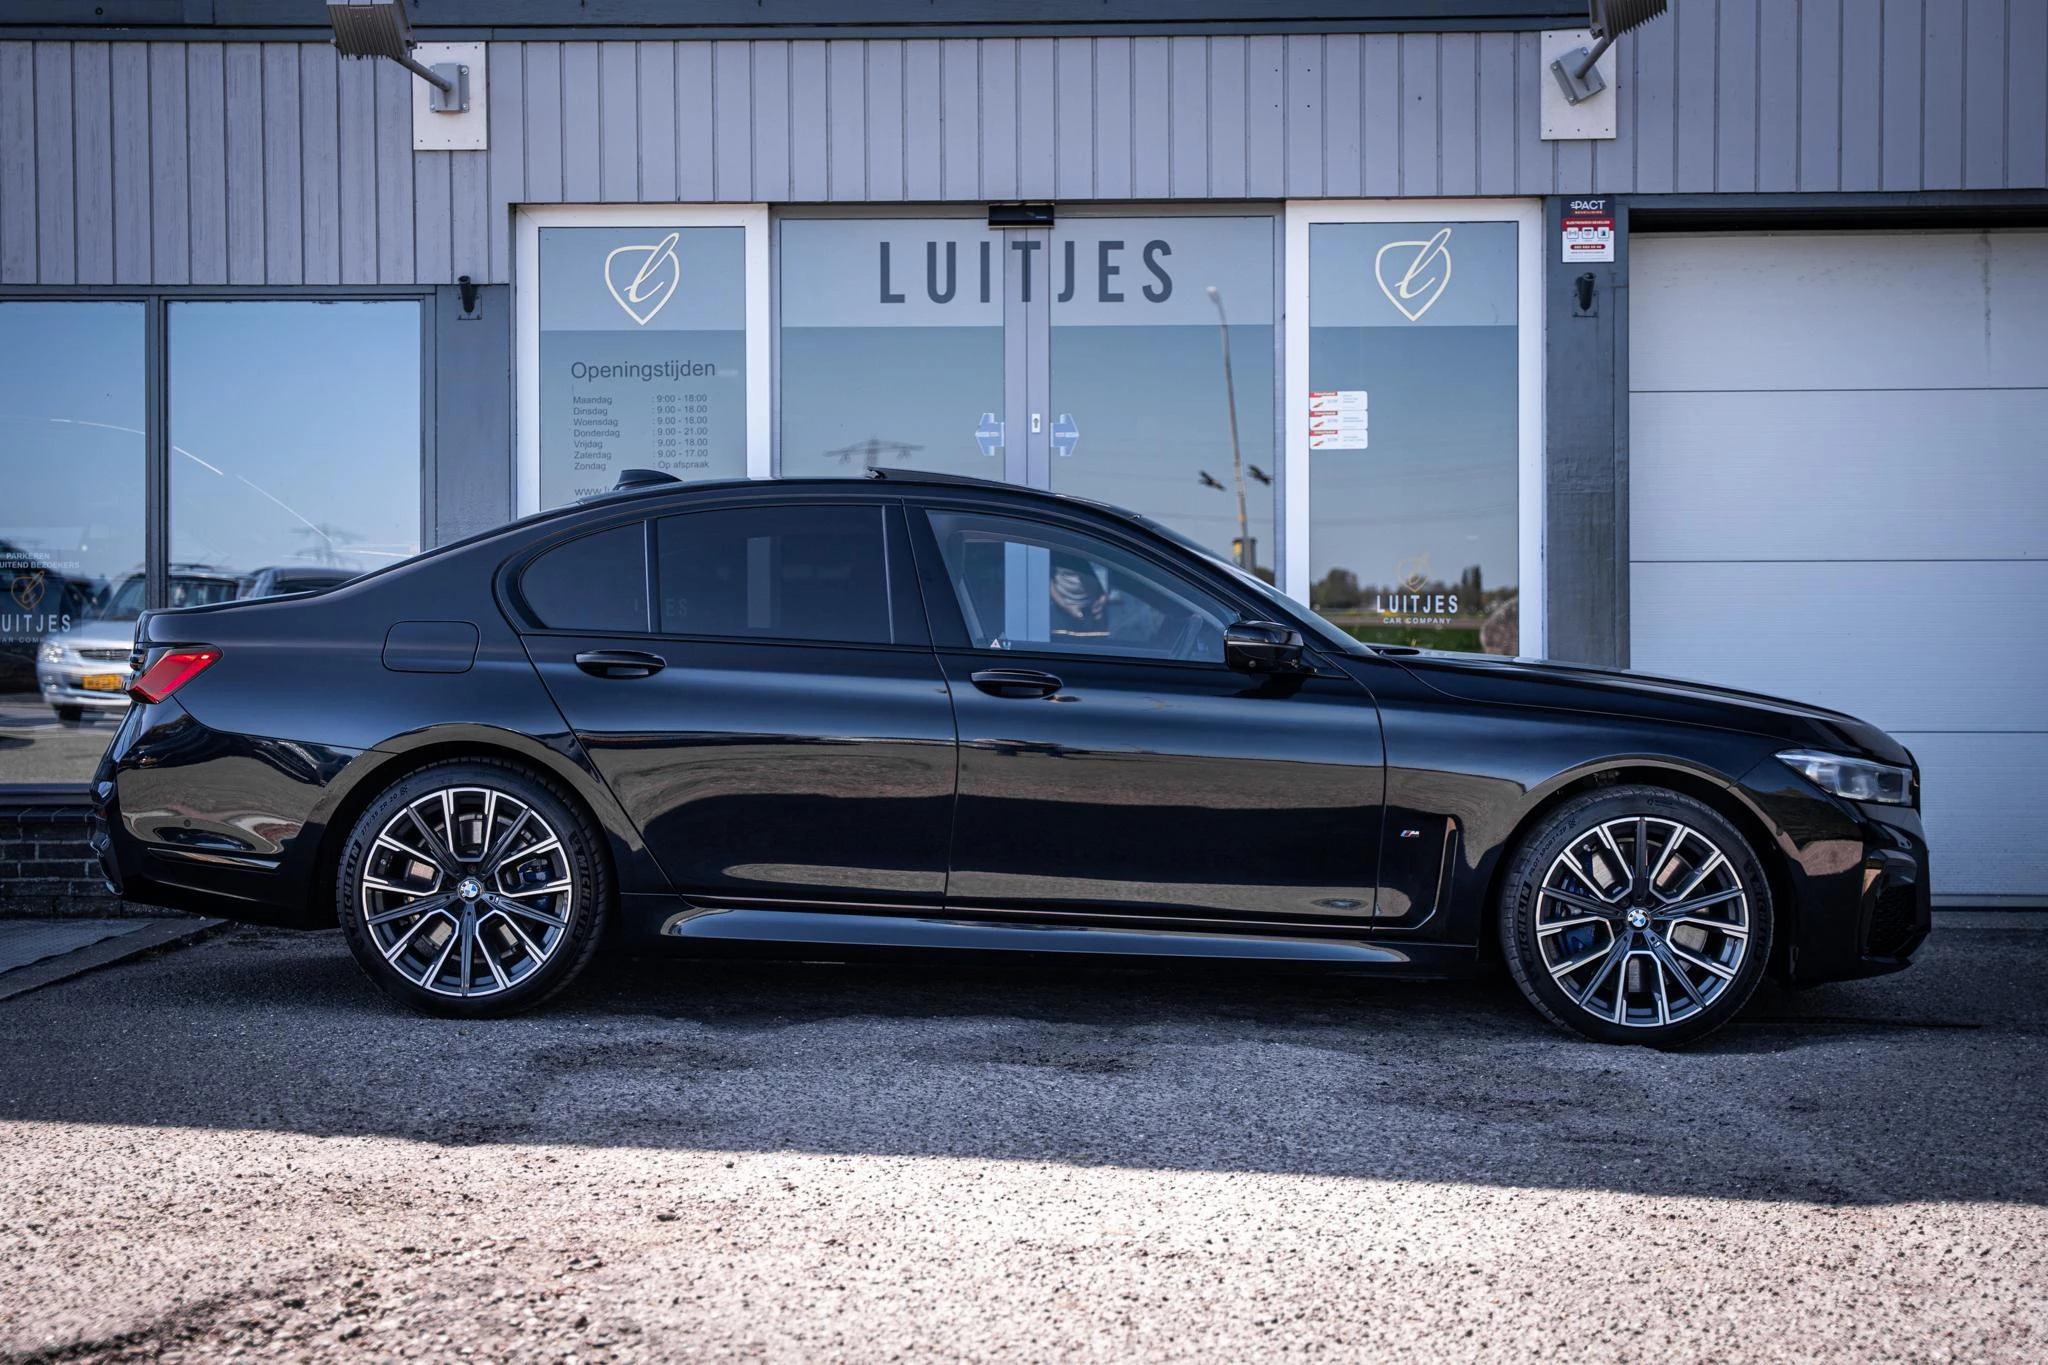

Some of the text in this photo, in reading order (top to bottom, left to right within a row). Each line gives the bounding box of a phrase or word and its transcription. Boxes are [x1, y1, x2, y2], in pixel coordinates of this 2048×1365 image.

[880, 240, 1173, 304] LUITJES
[571, 360, 715, 382] Openingstijden
[573, 396, 613, 406] Maandag
[573, 407, 608, 416] Dinsdag
[573, 418, 619, 427] Woensdag
[574, 429, 621, 438] Donderdag
[574, 440, 603, 450] Vrijdag
[574, 451, 612, 461] Zaterdag
[574, 462, 607, 471] Zondag
[658, 460, 710, 470] Op afspraak
[6, 552, 50, 560] PARKEREN
[0, 561, 28, 569] UITEND
[1376, 595, 1458, 613] LUITJES
[1, 614, 71, 632] UITJES
